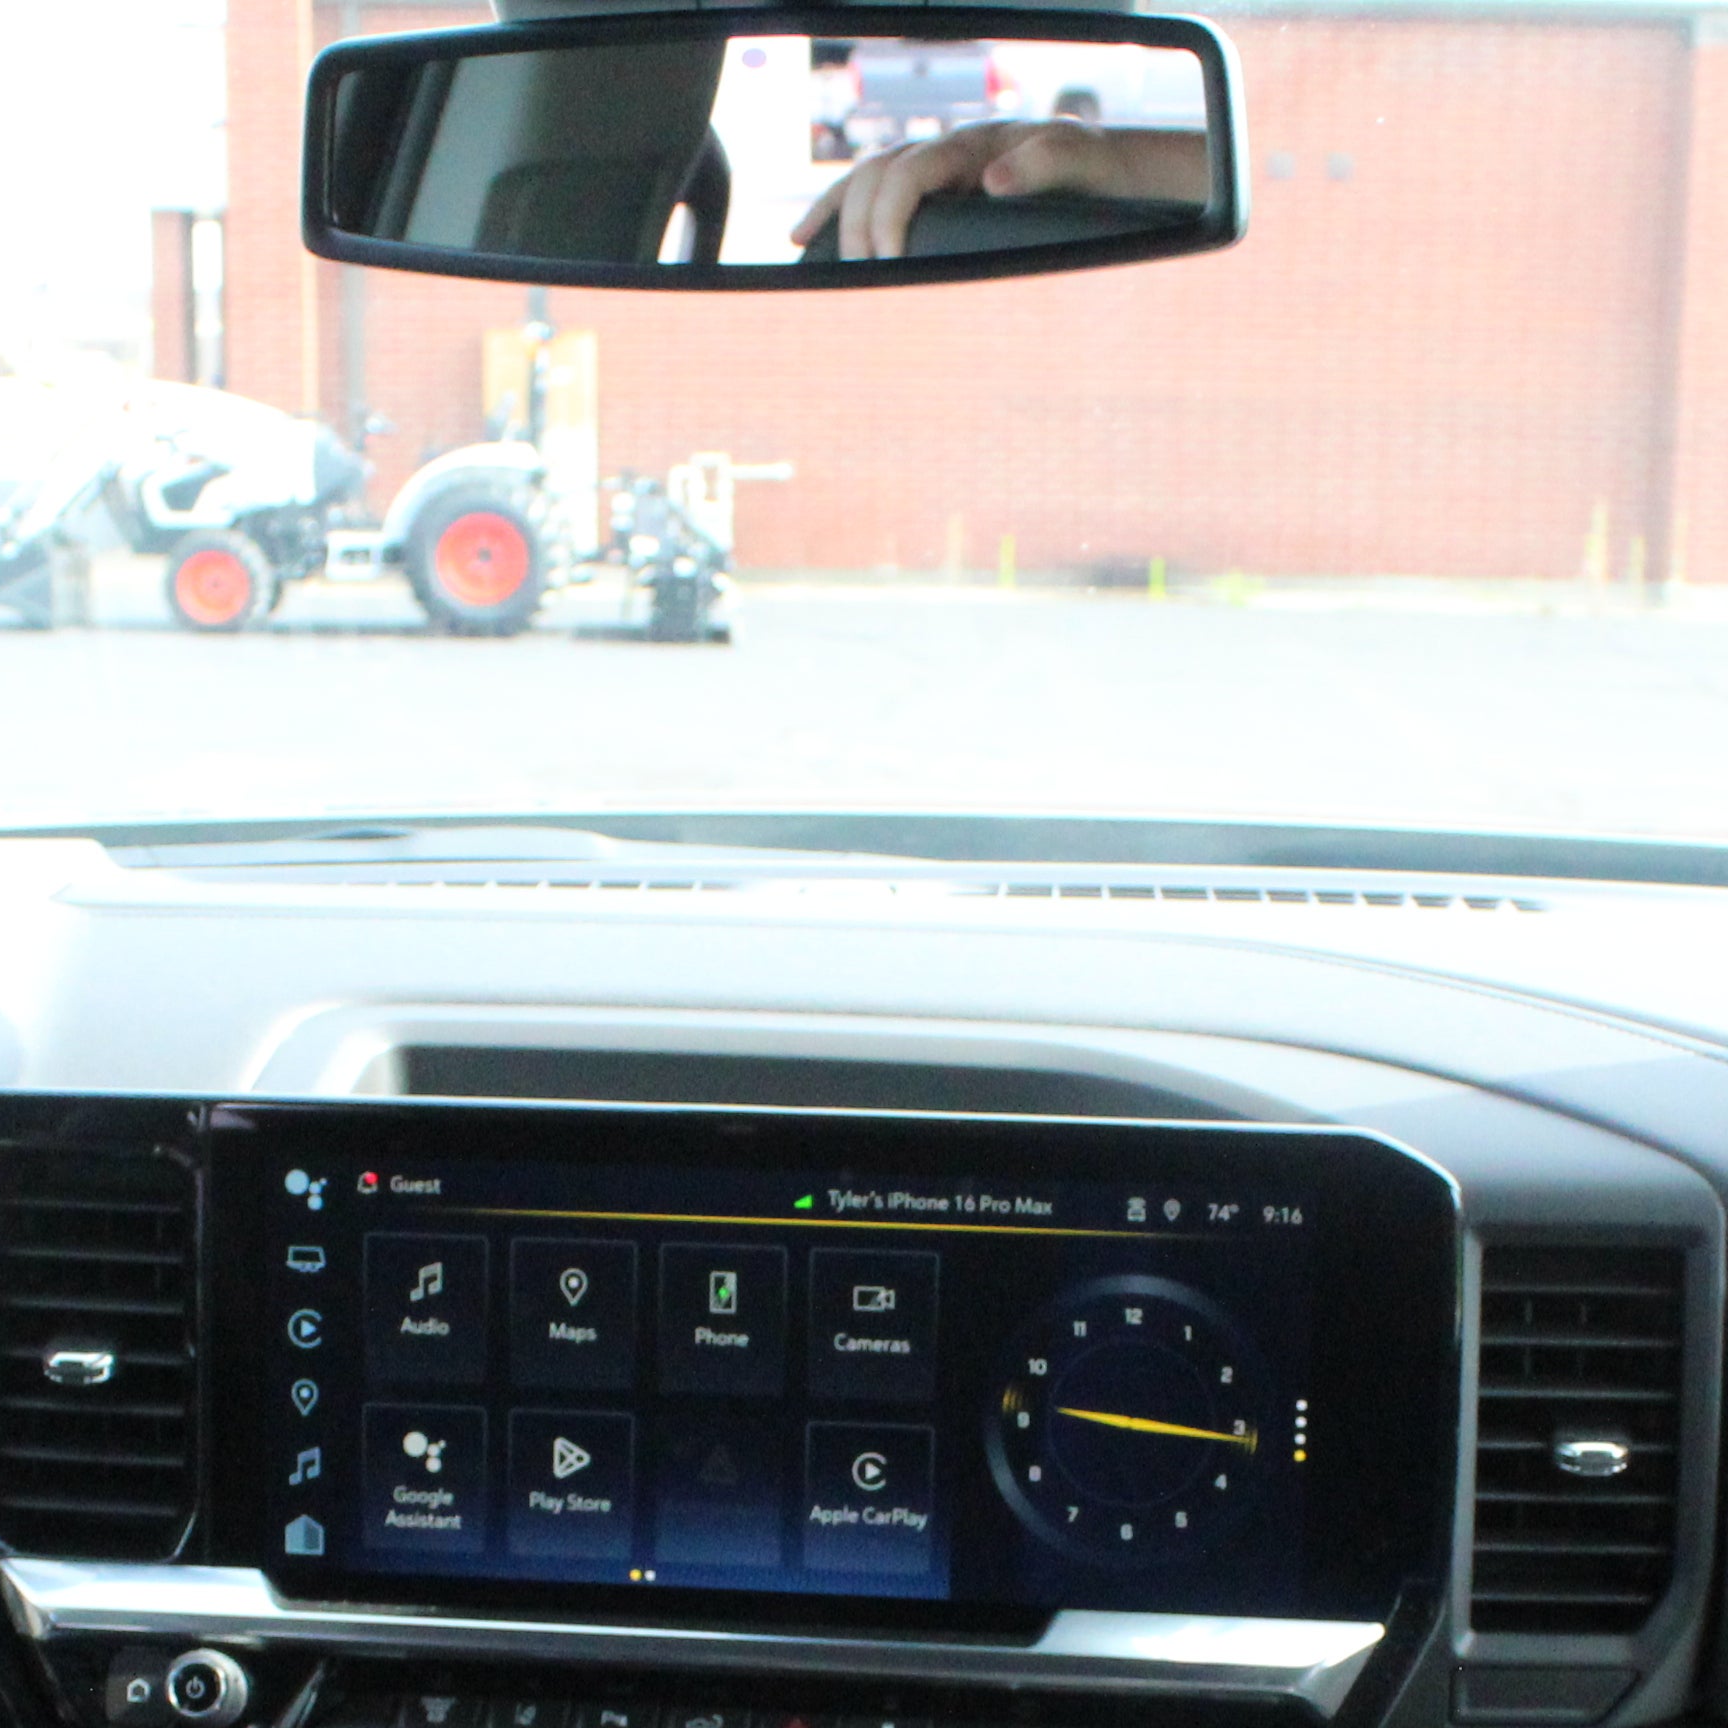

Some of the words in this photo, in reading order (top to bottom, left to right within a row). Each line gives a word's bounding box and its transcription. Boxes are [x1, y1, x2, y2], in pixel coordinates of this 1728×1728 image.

[390, 1175, 441, 1196] Guest
[826, 1189, 884, 1213] Tyler's
[887, 1191, 949, 1213] iPhone
[955, 1195, 977, 1213] 16
[979, 1196, 1012, 1214] Pro
[1015, 1198, 1053, 1216] Max
[1262, 1205, 1303, 1226] 9:16
[400, 1315, 451, 1338] Audio
[1125, 1307, 1143, 1325] 12
[549, 1321, 598, 1345] Maps
[694, 1325, 749, 1348] Phone
[1073, 1320, 1087, 1337] 11
[1183, 1324, 1193, 1342] 1
[833, 1332, 910, 1355] Cameras
[1028, 1358, 1048, 1376] 10
[1221, 1366, 1233, 1384] 2
[1233, 1419, 1246, 1436] 3
[1214, 1473, 1228, 1491] 4
[392, 1485, 454, 1508] Google
[529, 1490, 564, 1514] Play
[567, 1494, 611, 1514] Store
[385, 1510, 462, 1531] Assistant
[809, 1504, 859, 1528] Apple
[861, 1506, 928, 1532] CarPlay
[1067, 1506, 1079, 1523] 7
